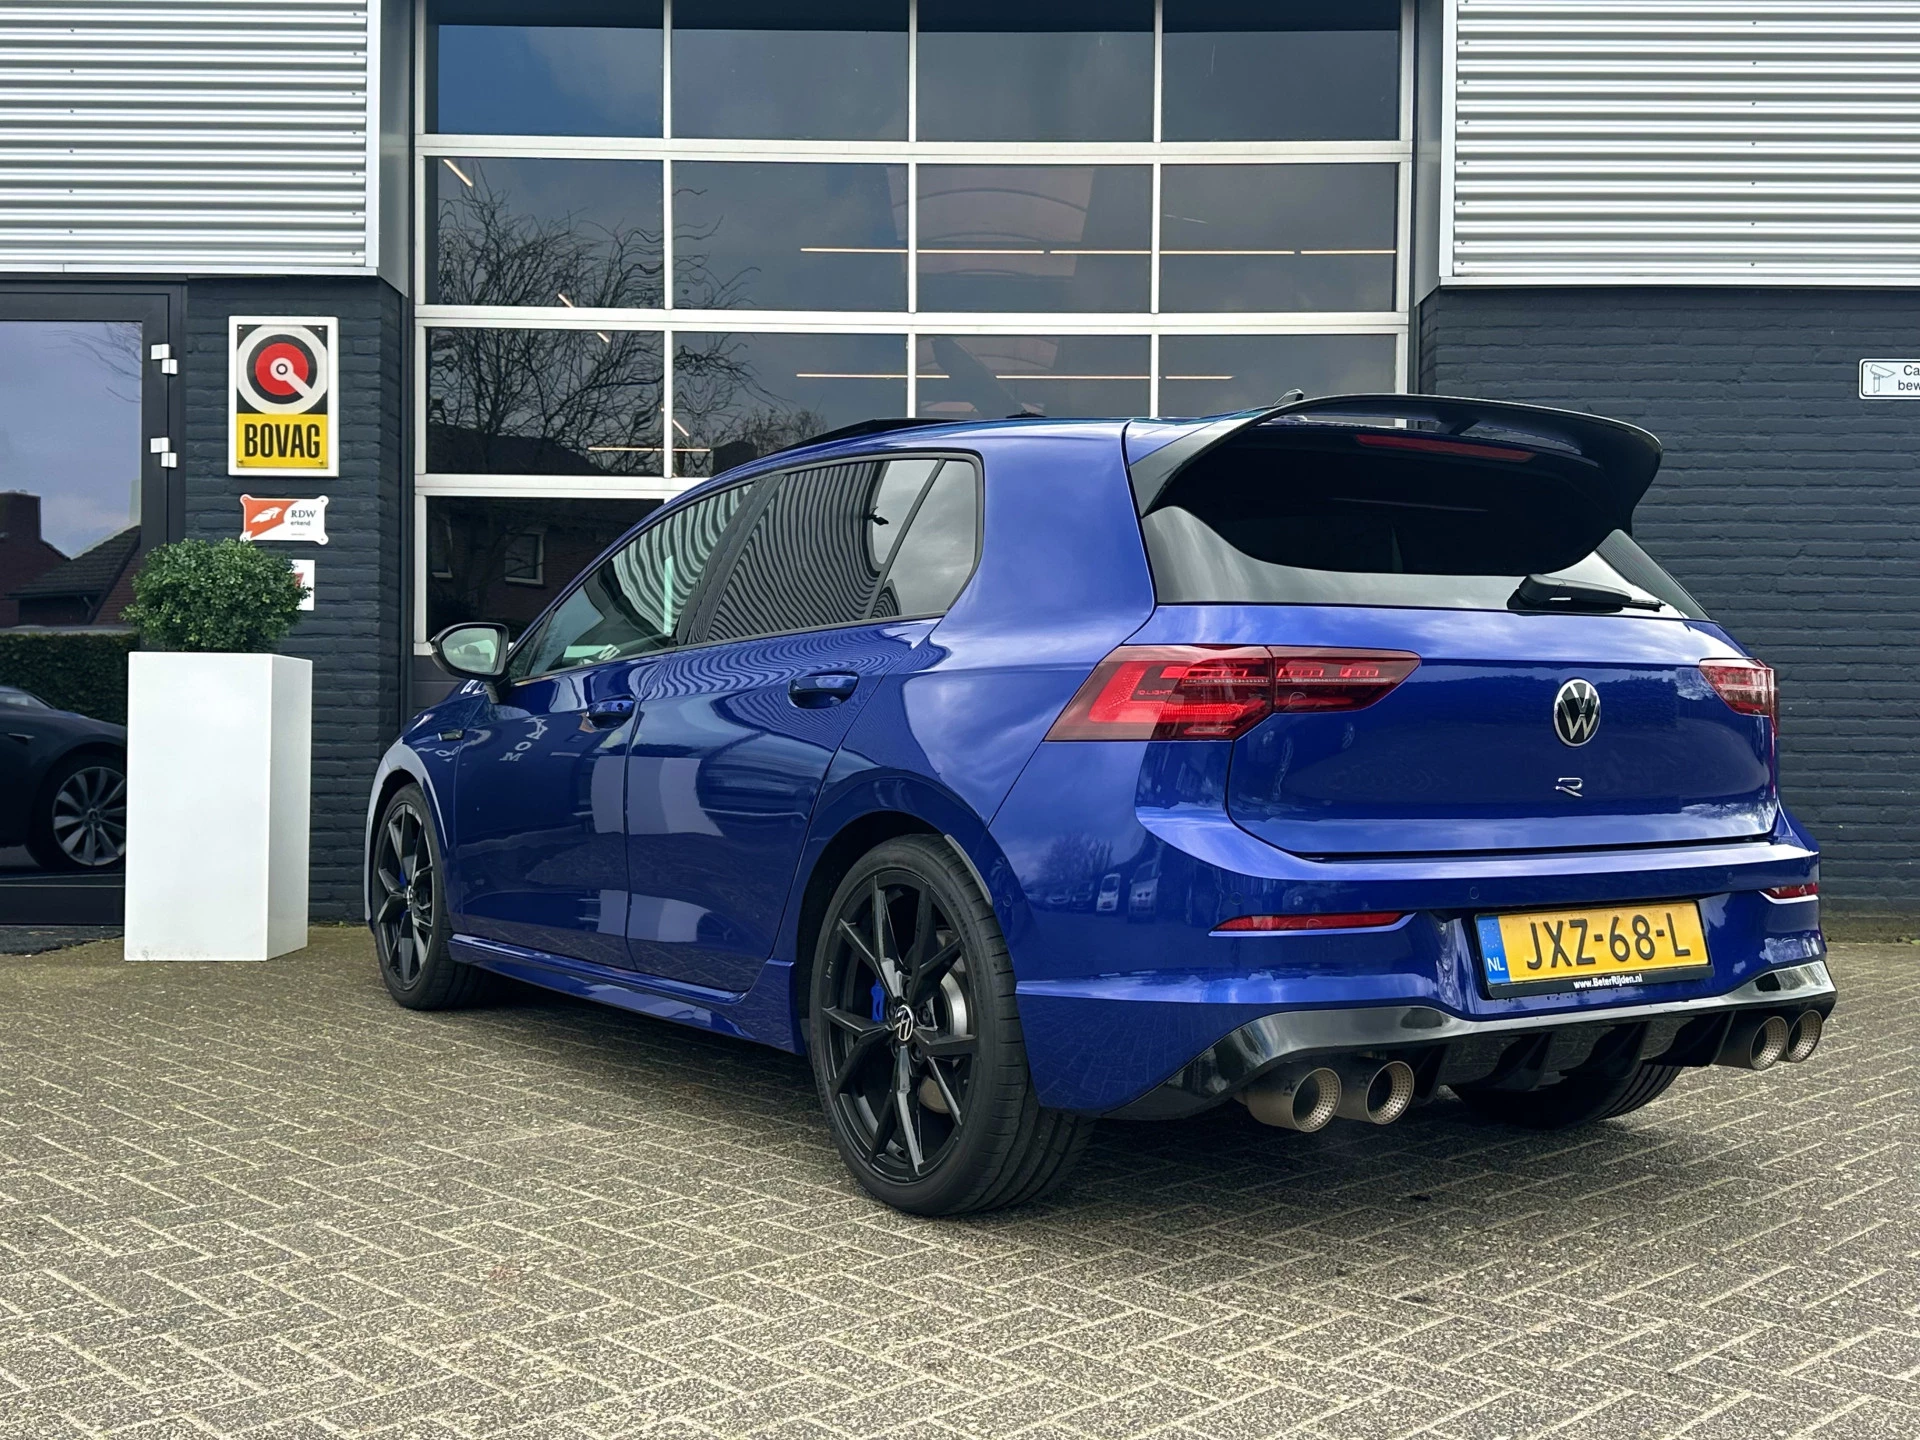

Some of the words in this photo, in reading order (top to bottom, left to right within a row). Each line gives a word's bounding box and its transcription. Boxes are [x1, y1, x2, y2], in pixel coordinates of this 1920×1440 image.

[245, 423, 320, 458] BOVAG
[290, 510, 317, 518] RDW
[1555, 777, 1583, 797] R
[1527, 913, 1691, 970] JXZ-68-L
[1487, 957, 1506, 972] NL
[1573, 973, 1643, 989] www.BeterRijden.nl
